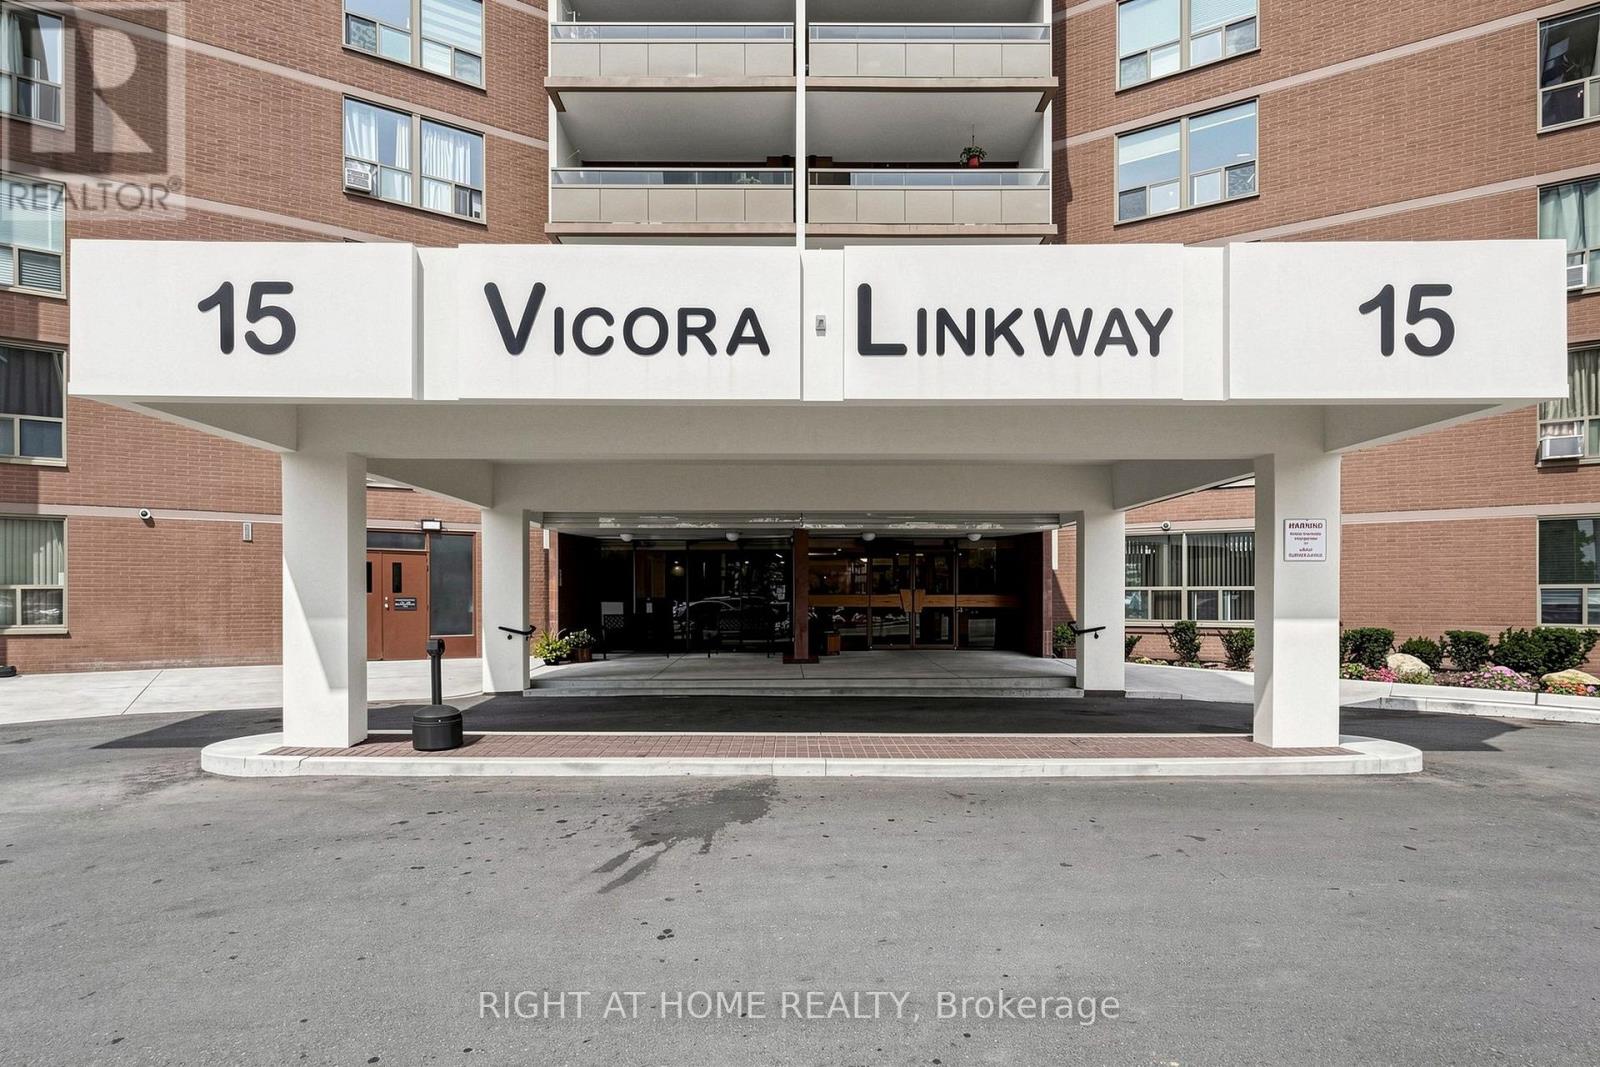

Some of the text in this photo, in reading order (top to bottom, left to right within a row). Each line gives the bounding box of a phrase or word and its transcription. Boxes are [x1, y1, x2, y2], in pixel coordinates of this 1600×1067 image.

[197, 281, 296, 355] 15
[483, 282, 1174, 357] VICORA LINKWAY
[1358, 283, 1455, 357] 15
